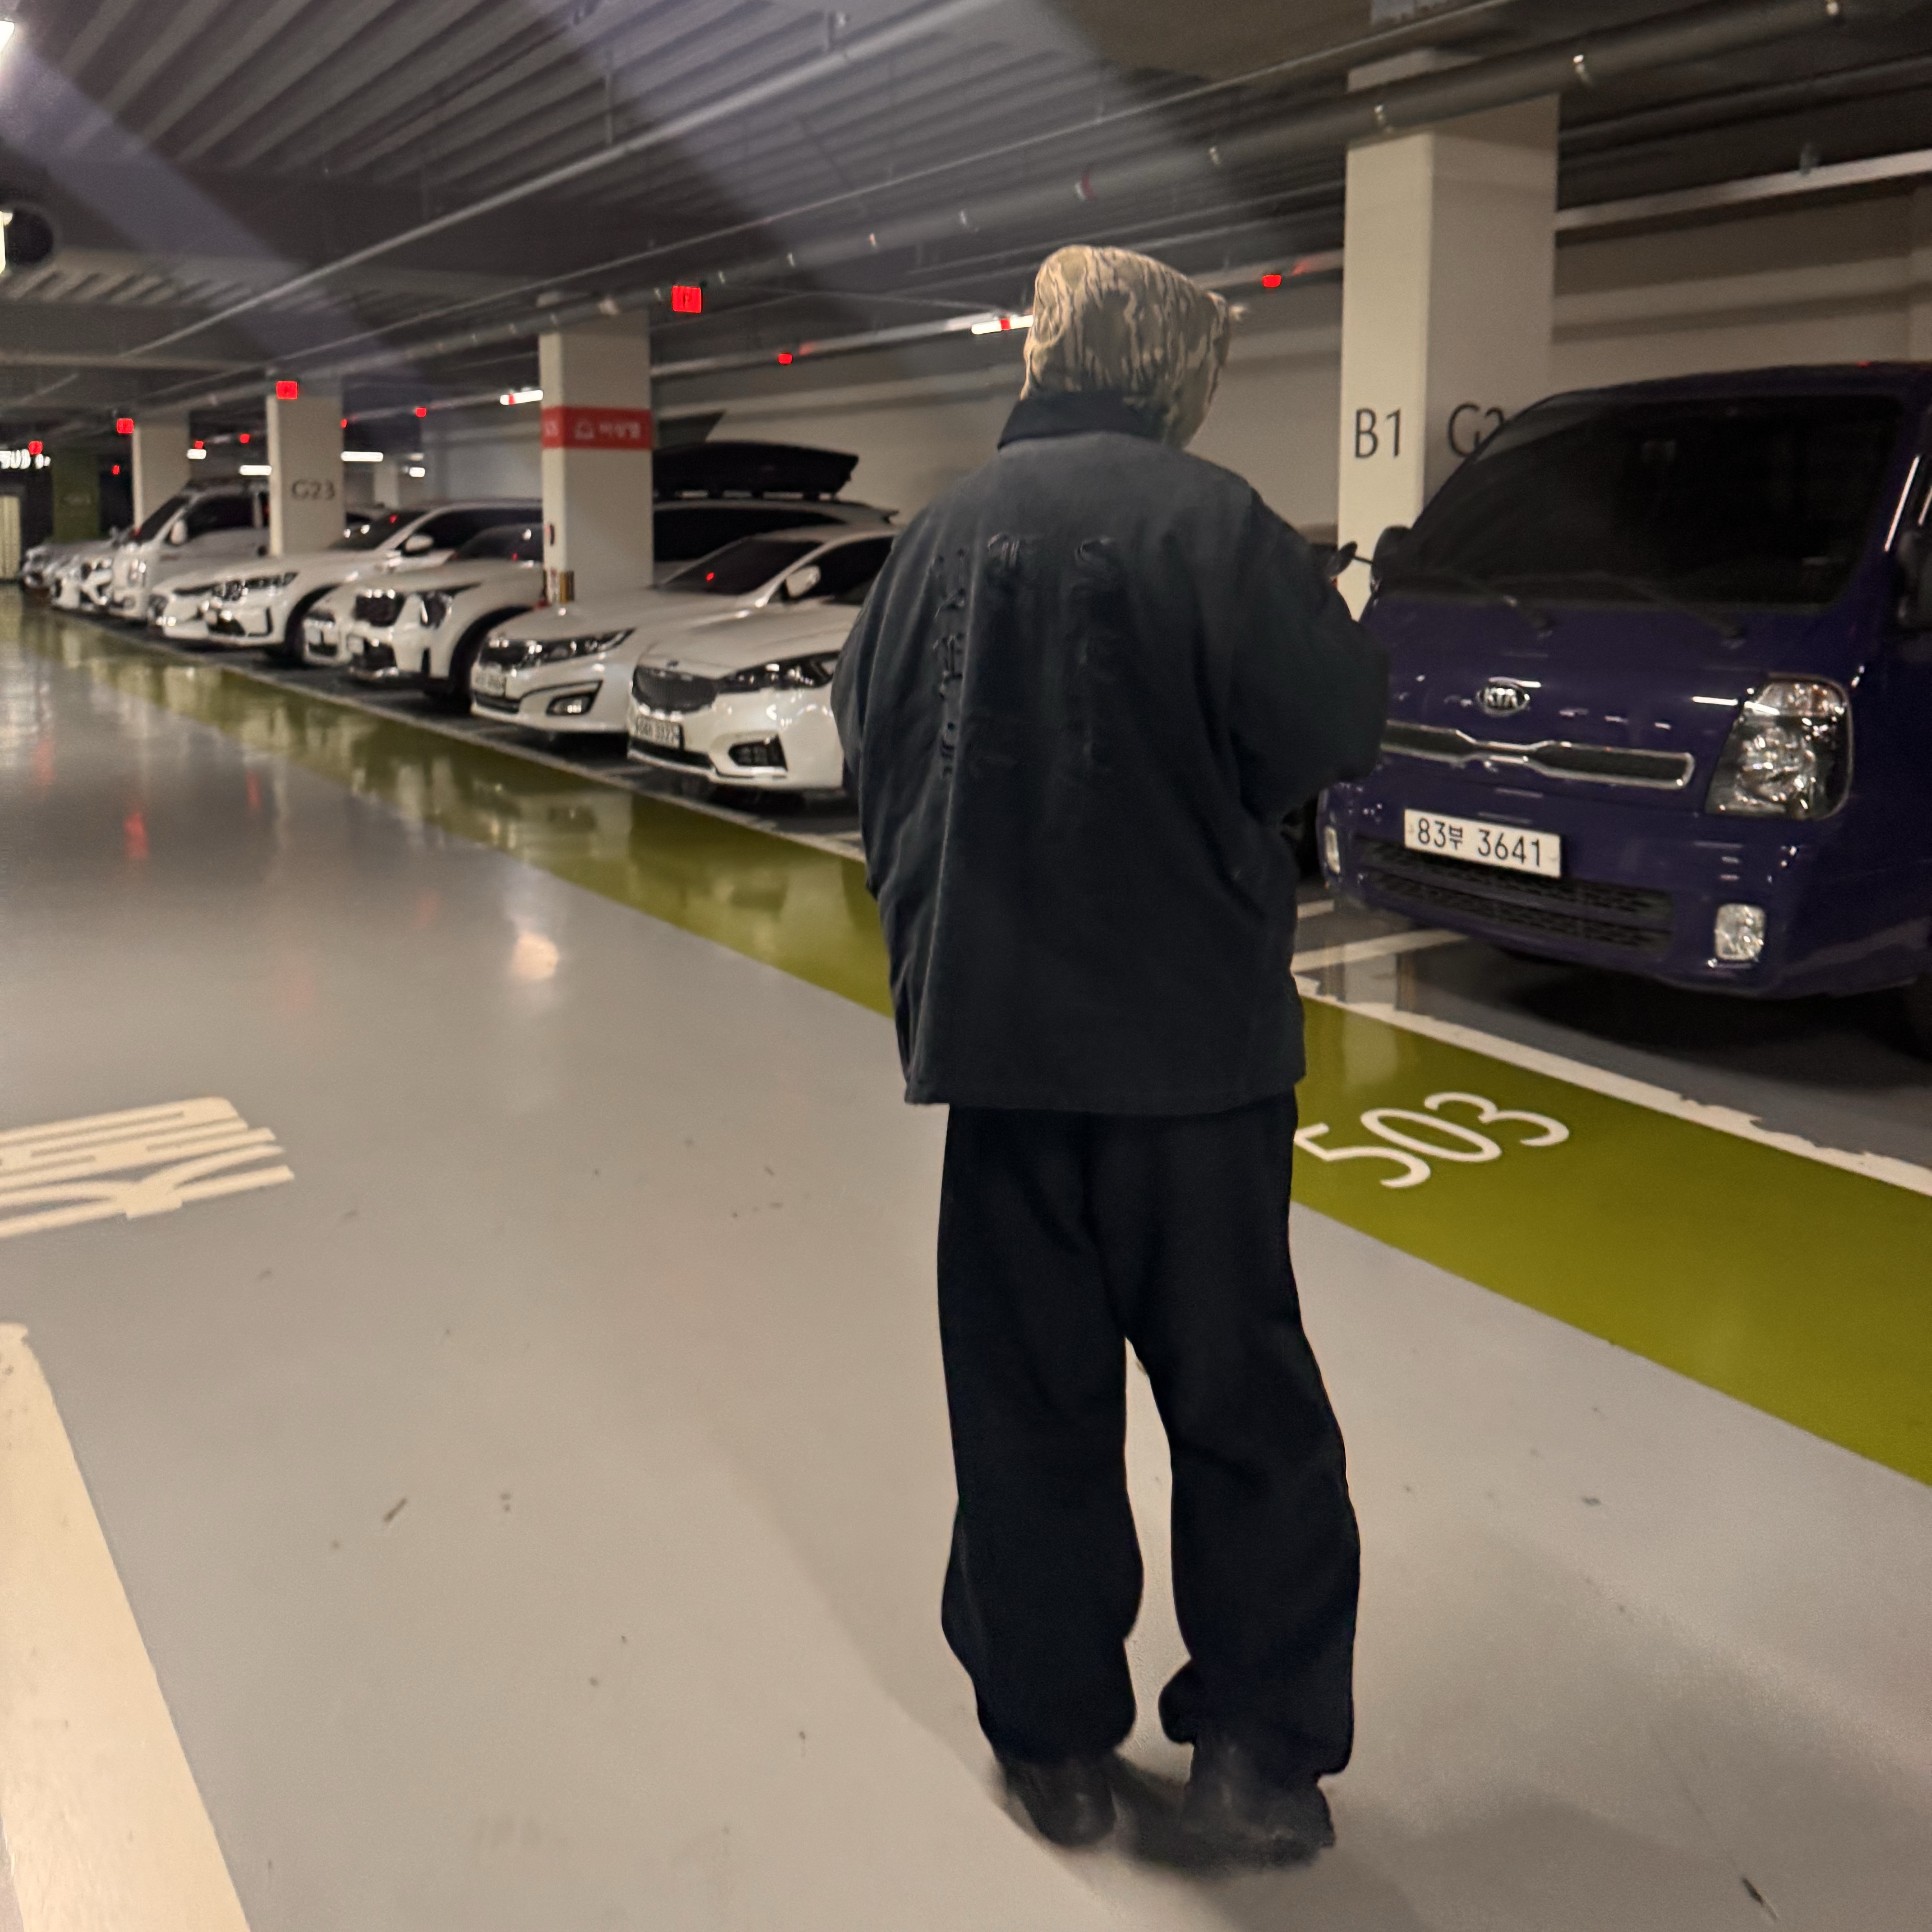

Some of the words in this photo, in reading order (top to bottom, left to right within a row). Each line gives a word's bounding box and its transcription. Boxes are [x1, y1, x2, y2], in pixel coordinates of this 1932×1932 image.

[1355, 408, 1401, 459] B1
[1418, 818, 1463, 851] 83부
[1478, 828, 1541, 868] 3641
[1293, 1091, 1570, 1188] 503
